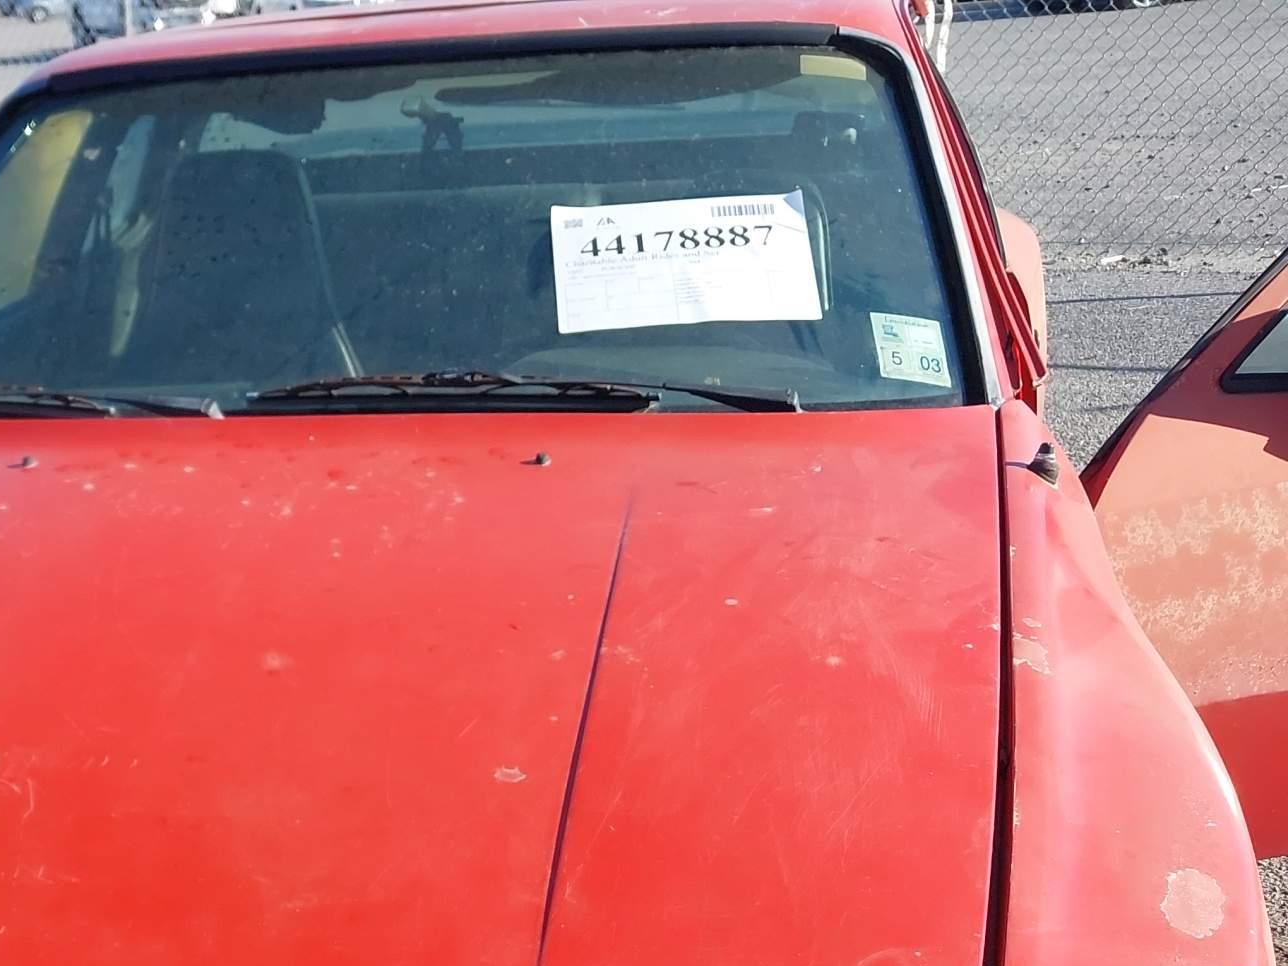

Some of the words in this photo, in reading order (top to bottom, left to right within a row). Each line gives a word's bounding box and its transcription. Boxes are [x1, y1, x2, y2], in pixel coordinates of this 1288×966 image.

[580, 225, 773, 257] 44178887
[892, 351, 903, 366] 5
[920, 355, 942, 373] 03
